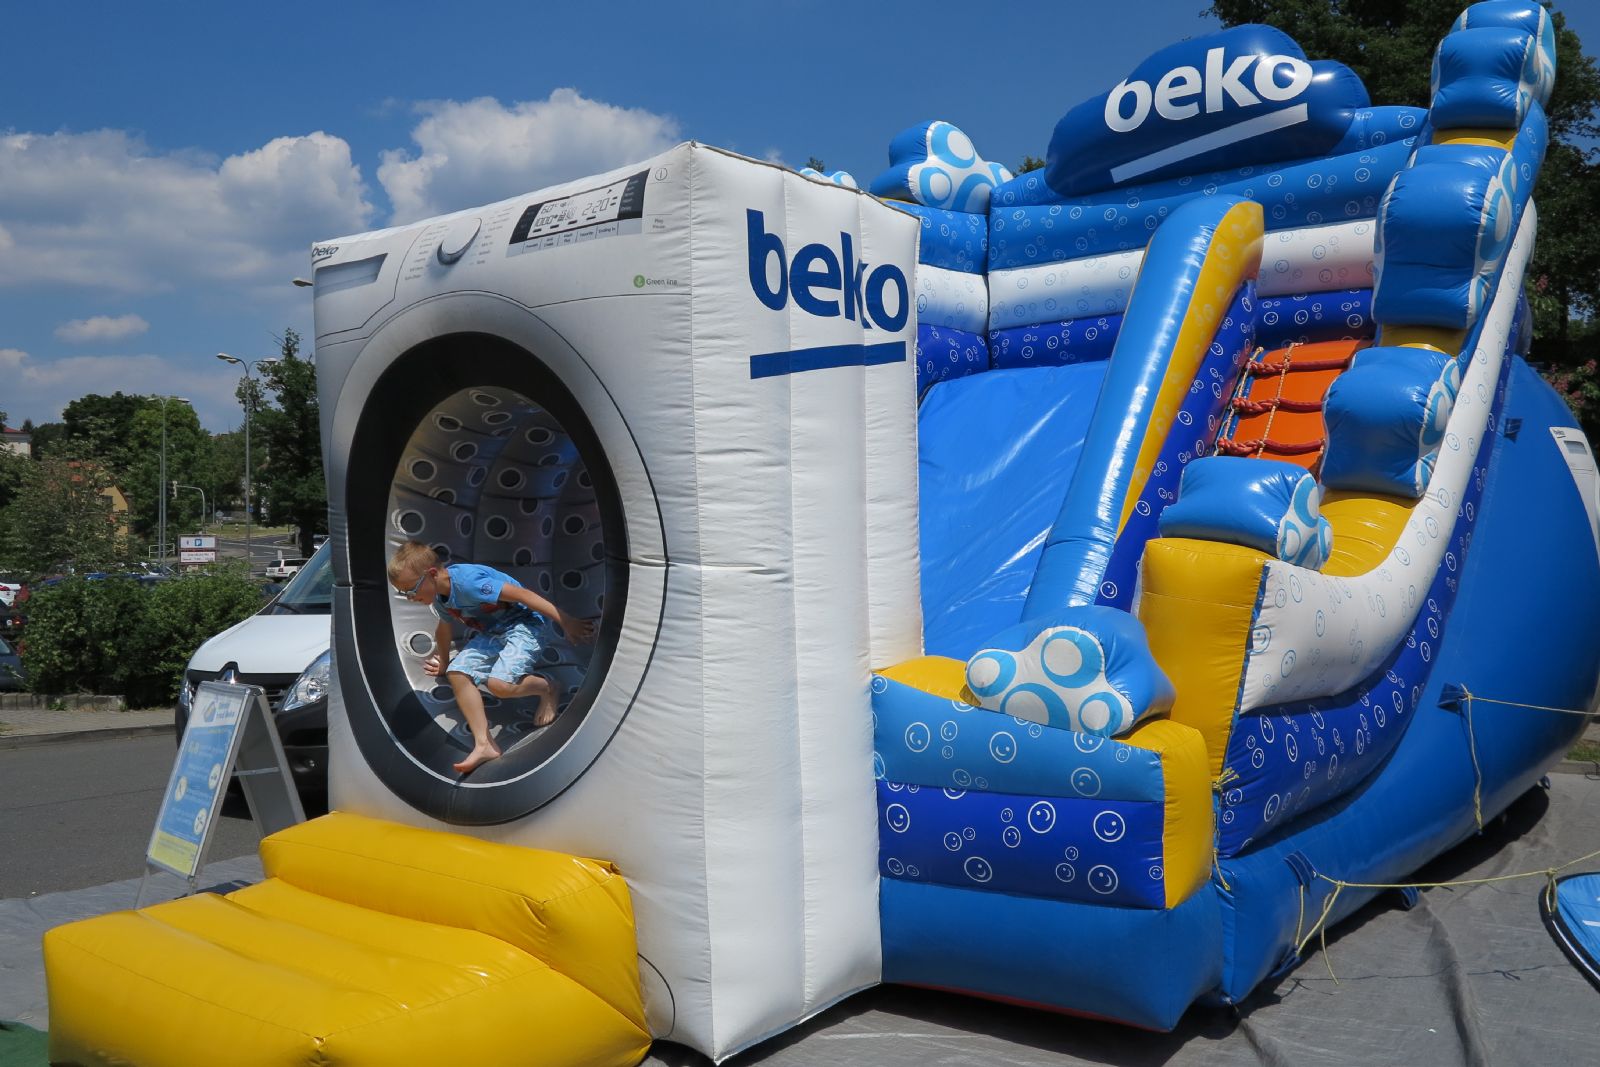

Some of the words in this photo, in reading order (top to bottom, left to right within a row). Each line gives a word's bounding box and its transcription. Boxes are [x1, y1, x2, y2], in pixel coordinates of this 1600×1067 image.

[1104, 47, 1313, 133] beko
[312, 245, 339, 257] beko
[746, 208, 909, 333] beko
[645, 278, 665, 286] Green
